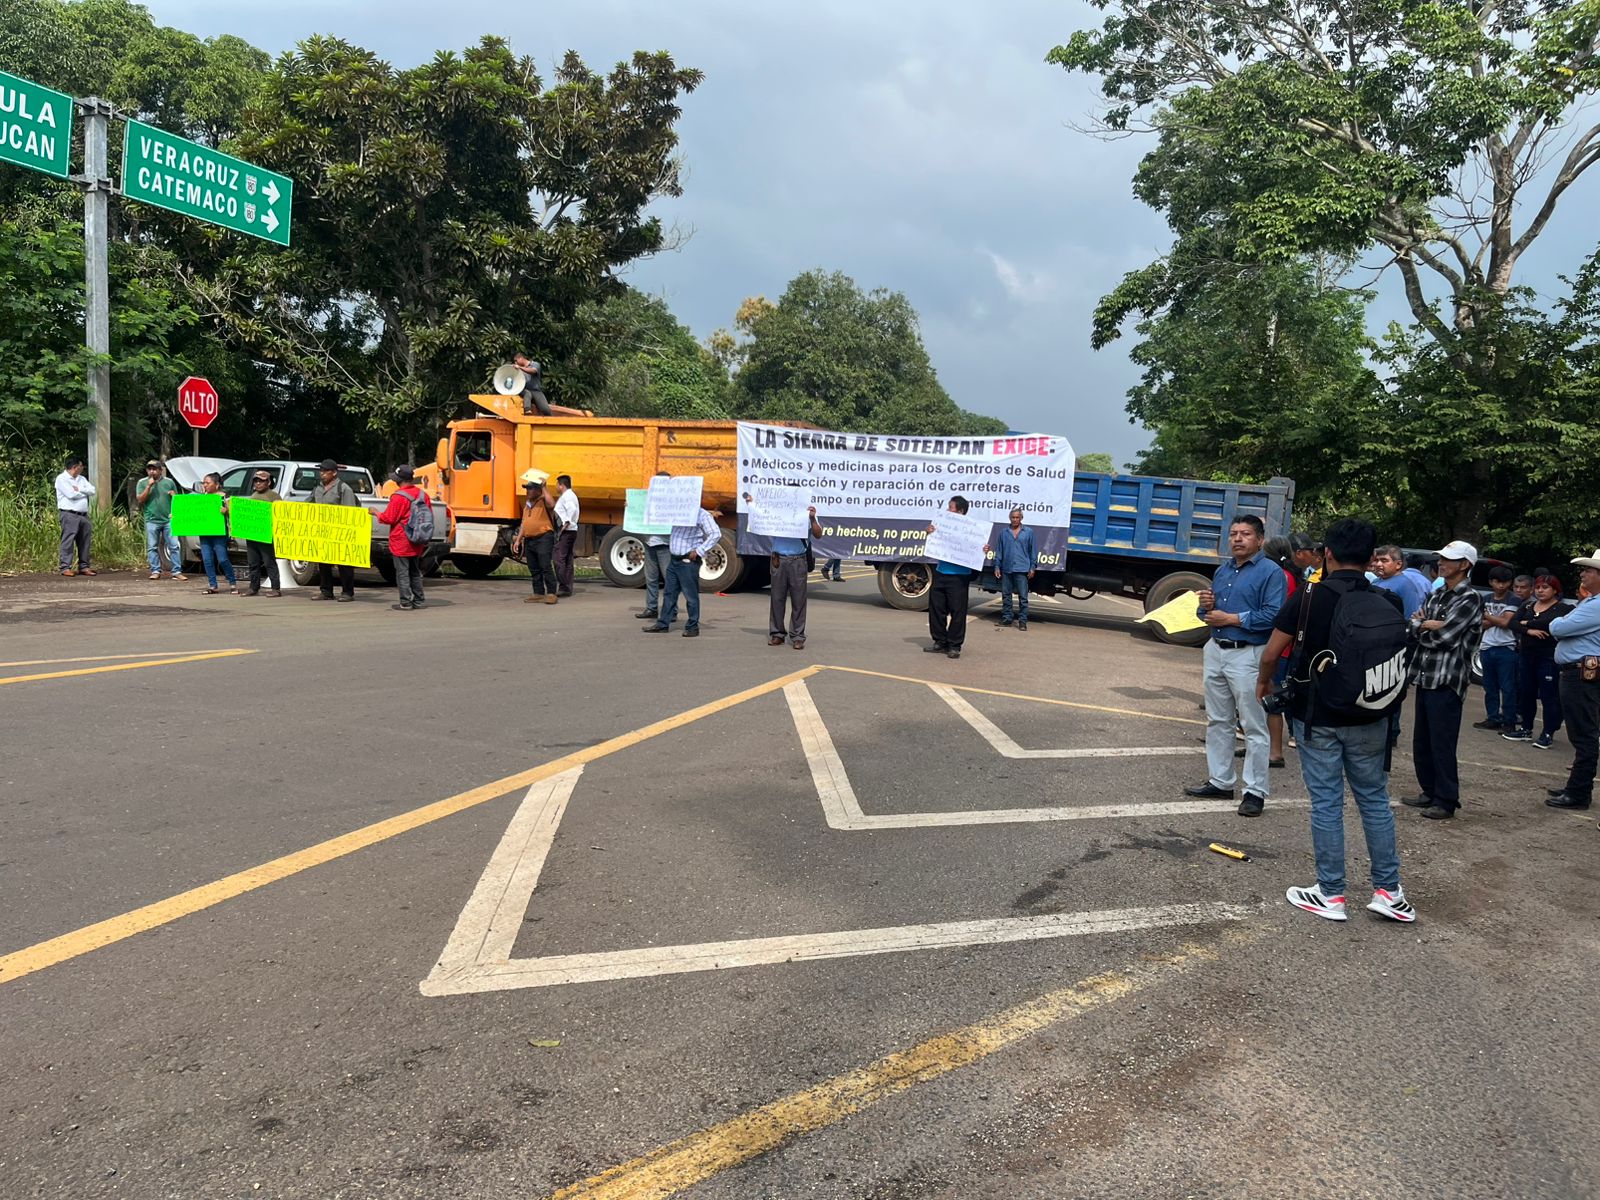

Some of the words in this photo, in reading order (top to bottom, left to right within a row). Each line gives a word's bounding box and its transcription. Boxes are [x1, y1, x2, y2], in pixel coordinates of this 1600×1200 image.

[0, 85, 56, 128] ULA
[0, 121, 55, 160] UCAN
[140, 135, 240, 191] VERACRUZ
[138, 167, 237, 218] CATEMACO
[183, 390, 215, 415] ALTO
[755, 428, 777, 448] LA
[784, 431, 847, 451] SIERRA
[854, 436, 879, 452] DE
[886, 438, 985, 455] SOTEAPAN
[992, 436, 1056, 456] EXIGE:
[751, 457, 803, 470] Médicos
[807, 462, 815, 473] y
[819, 460, 884, 472] medicinas
[889, 464, 918, 475] para
[922, 462, 942, 473] los
[947, 462, 1001, 475] Centros
[1006, 464, 1022, 476] de
[1026, 466, 1066, 479] Salud
[750, 474, 836, 488] Construcción
[841, 480, 848, 491] y
[853, 478, 924, 492] reparación
[929, 480, 945, 491] de
[950, 481, 1020, 494] carreteras
[811, 495, 842, 507] ampo
[846, 496, 861, 505] en
[865, 496, 933, 508] producción
[937, 499, 944, 509] y
[273, 503, 316, 522] CONCRETO
[318, 505, 366, 528] HIDRAULICO
[275, 520, 295, 536] PARA
[298, 522, 308, 537] LA
[311, 524, 356, 543] CARRETERA
[822, 527, 833, 536] re
[837, 525, 880, 539] hechos,
[883, 528, 897, 538] no
[852, 543, 897, 556] ¡Luchar
[900, 545, 924, 556] unid
[1037, 552, 1060, 565] los!
[1365, 646, 1407, 697] NIKE
